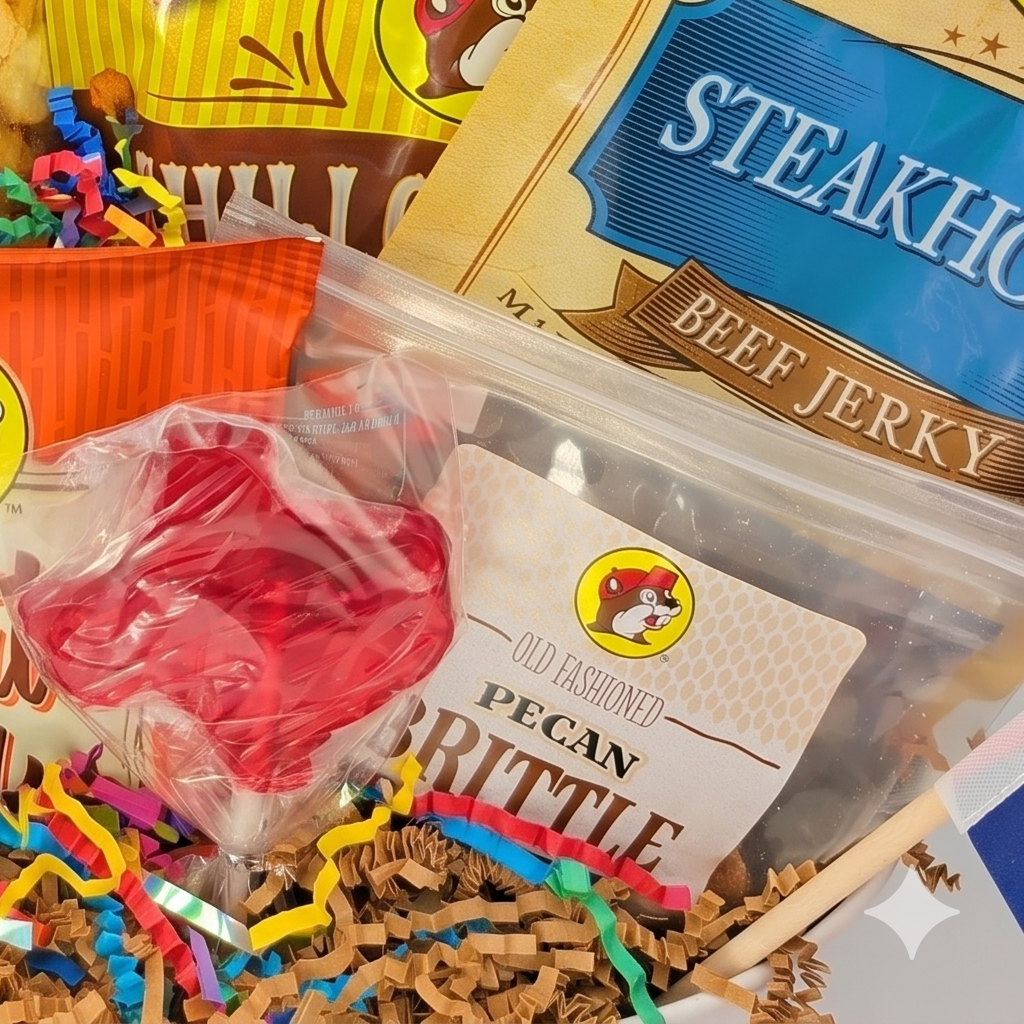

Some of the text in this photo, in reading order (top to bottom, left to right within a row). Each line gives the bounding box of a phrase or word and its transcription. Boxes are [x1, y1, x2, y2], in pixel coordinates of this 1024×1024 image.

[670, 291, 808, 388] BEEF
[793, 367, 1006, 477] JERKY
[512, 631, 665, 727] OLD FASHIONED
[474, 681, 640, 779] PECAN
